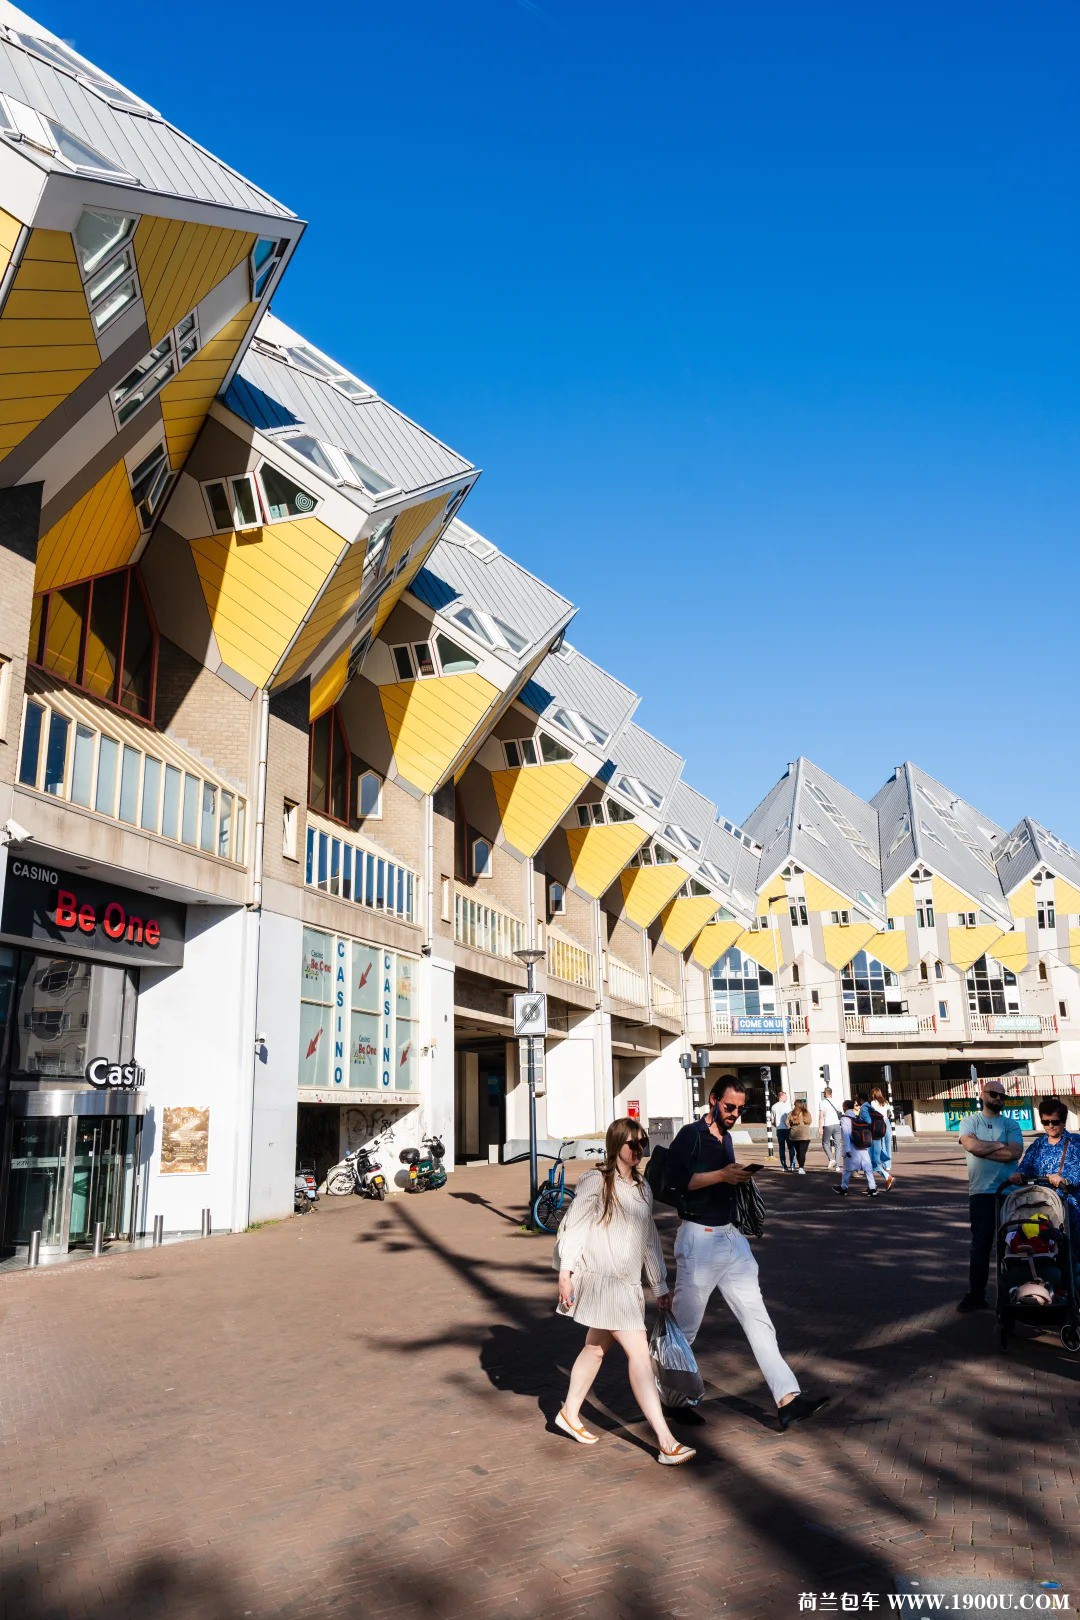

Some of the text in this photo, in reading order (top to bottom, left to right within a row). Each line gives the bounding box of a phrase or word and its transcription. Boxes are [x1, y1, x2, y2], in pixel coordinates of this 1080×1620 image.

[12, 861, 59, 885] CASINO
[55, 889, 161, 946] Be One
[334, 942, 345, 1084] CASINO
[382, 956, 391, 1086] CASINO
[740, 1019, 762, 1028] COME
[763, 1019, 775, 1028] ON
[358, 1043, 377, 1055] Be One
[359, 1034, 371, 1043] Casino
